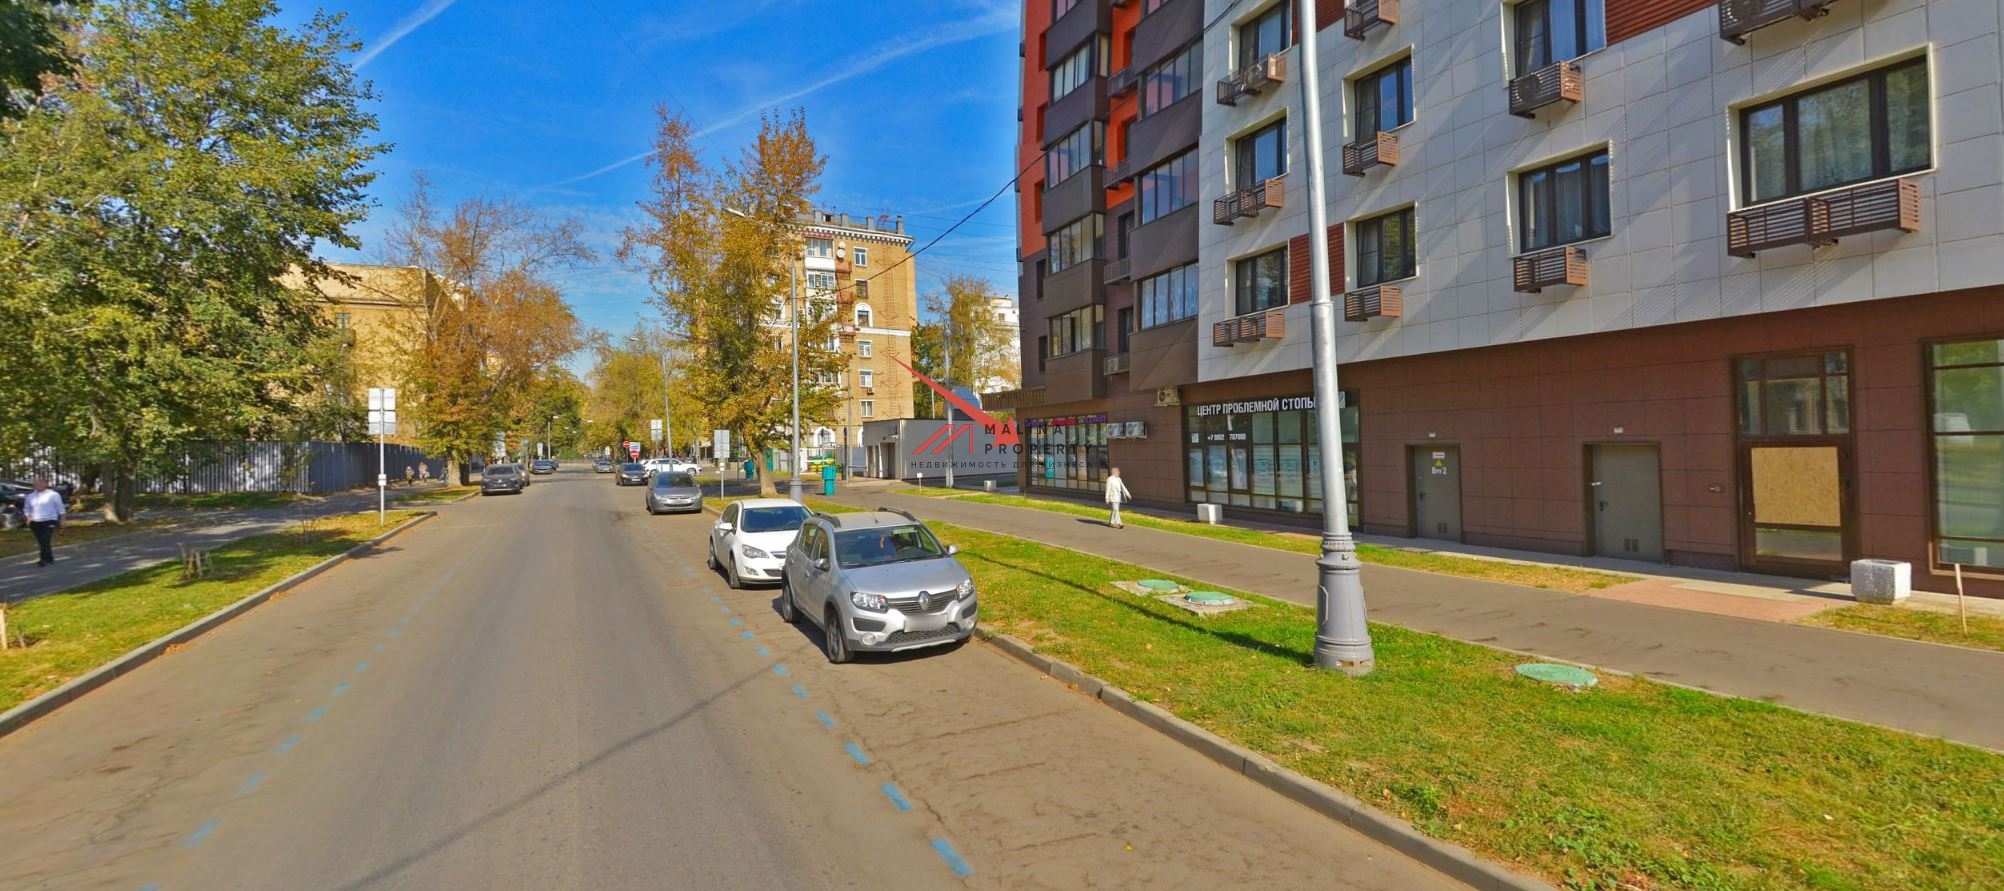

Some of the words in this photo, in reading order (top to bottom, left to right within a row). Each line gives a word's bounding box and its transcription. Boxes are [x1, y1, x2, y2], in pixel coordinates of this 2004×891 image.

[1197, 404, 1221, 416] ЦЕНТР
[1223, 398, 1279, 414] ПРОБЛЕМНОЙ
[1282, 397, 1316, 410] СТОПЫ
